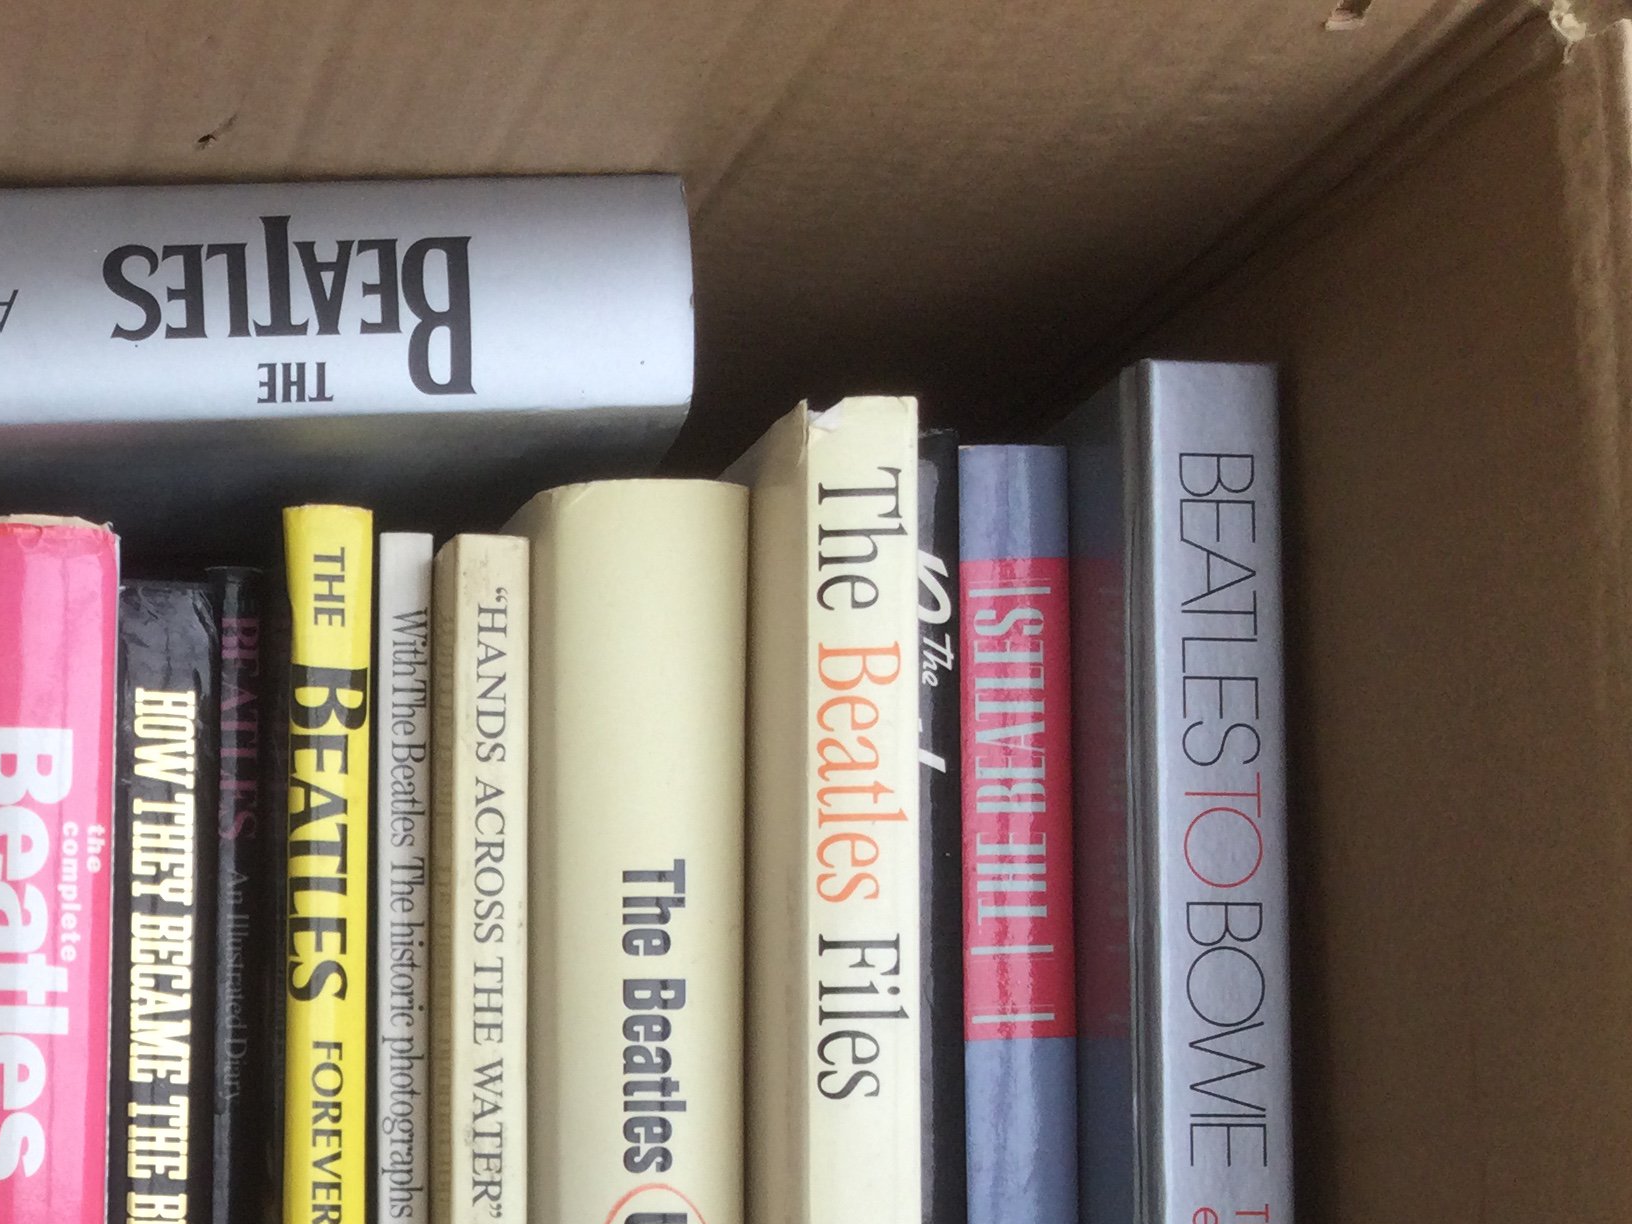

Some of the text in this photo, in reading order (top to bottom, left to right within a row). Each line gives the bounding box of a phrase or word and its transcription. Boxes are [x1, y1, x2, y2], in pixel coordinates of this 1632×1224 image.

[102, 215, 478, 396] BEATLES
[258, 361, 335, 403] THE
[313, 547, 346, 628] THE
[922, 634, 954, 687] The
[133, 688, 195, 789] HOW
[815, 466, 909, 1100] The Beatles Files
[132, 794, 194, 905] THEY
[287, 663, 368, 1002] BEATLES
[390, 742, 426, 847] Beatles
[1179, 453, 1267, 1167] BEATLES TO BOWIE
[57, 821, 105, 962] the complete
[390, 855, 425, 913] The
[473, 777, 505, 1045] ACROSS THE
[623, 859, 687, 955] The
[127, 911, 193, 1085] BECAME
[389, 921, 426, 1027] historic
[381, 1035, 425, 1218] photographs
[623, 978, 687, 1173] Beatles
[126, 1096, 189, 1180] THE
